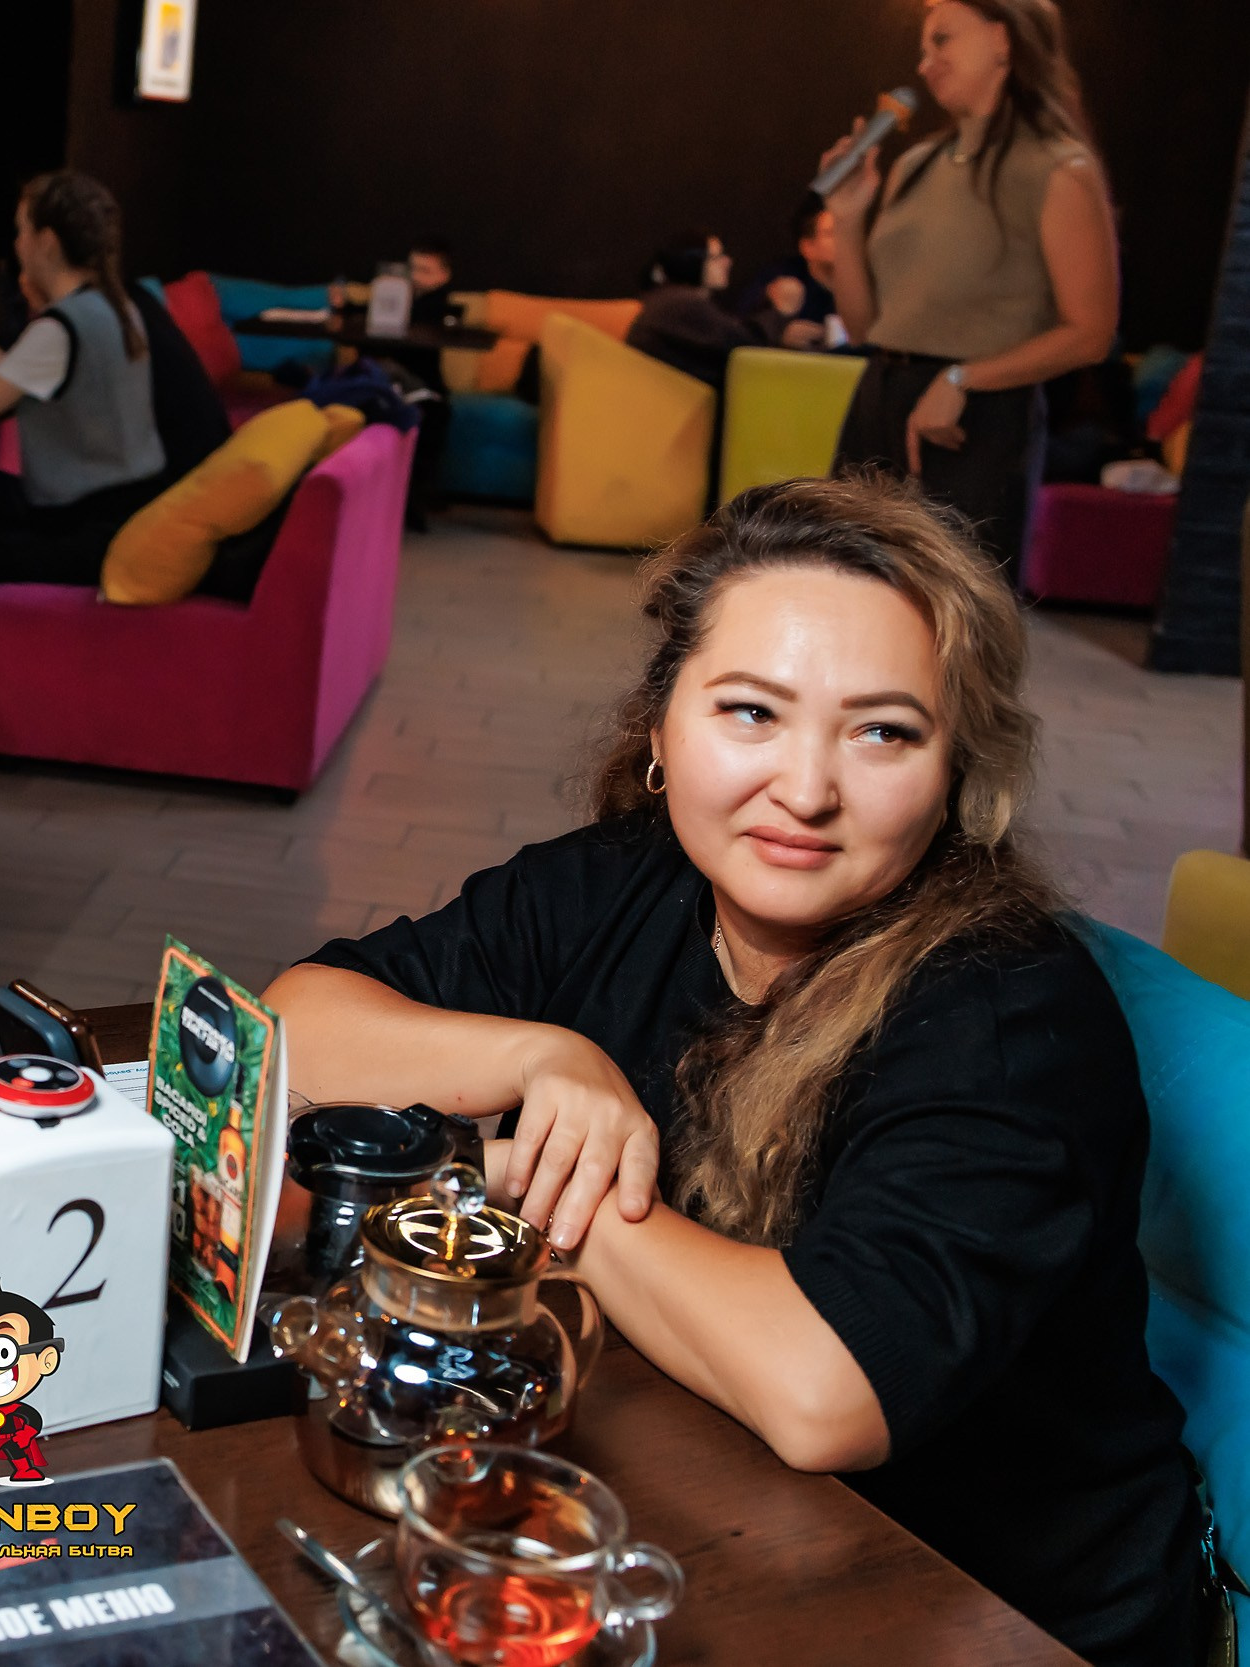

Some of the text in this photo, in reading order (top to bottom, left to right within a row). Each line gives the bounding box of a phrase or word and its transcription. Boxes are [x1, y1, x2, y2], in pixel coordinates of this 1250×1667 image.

[162, 1113, 196, 1148] COLA
[42, 1198, 107, 1310] 2
[49, 1583, 176, 1630] МЕНЮ
